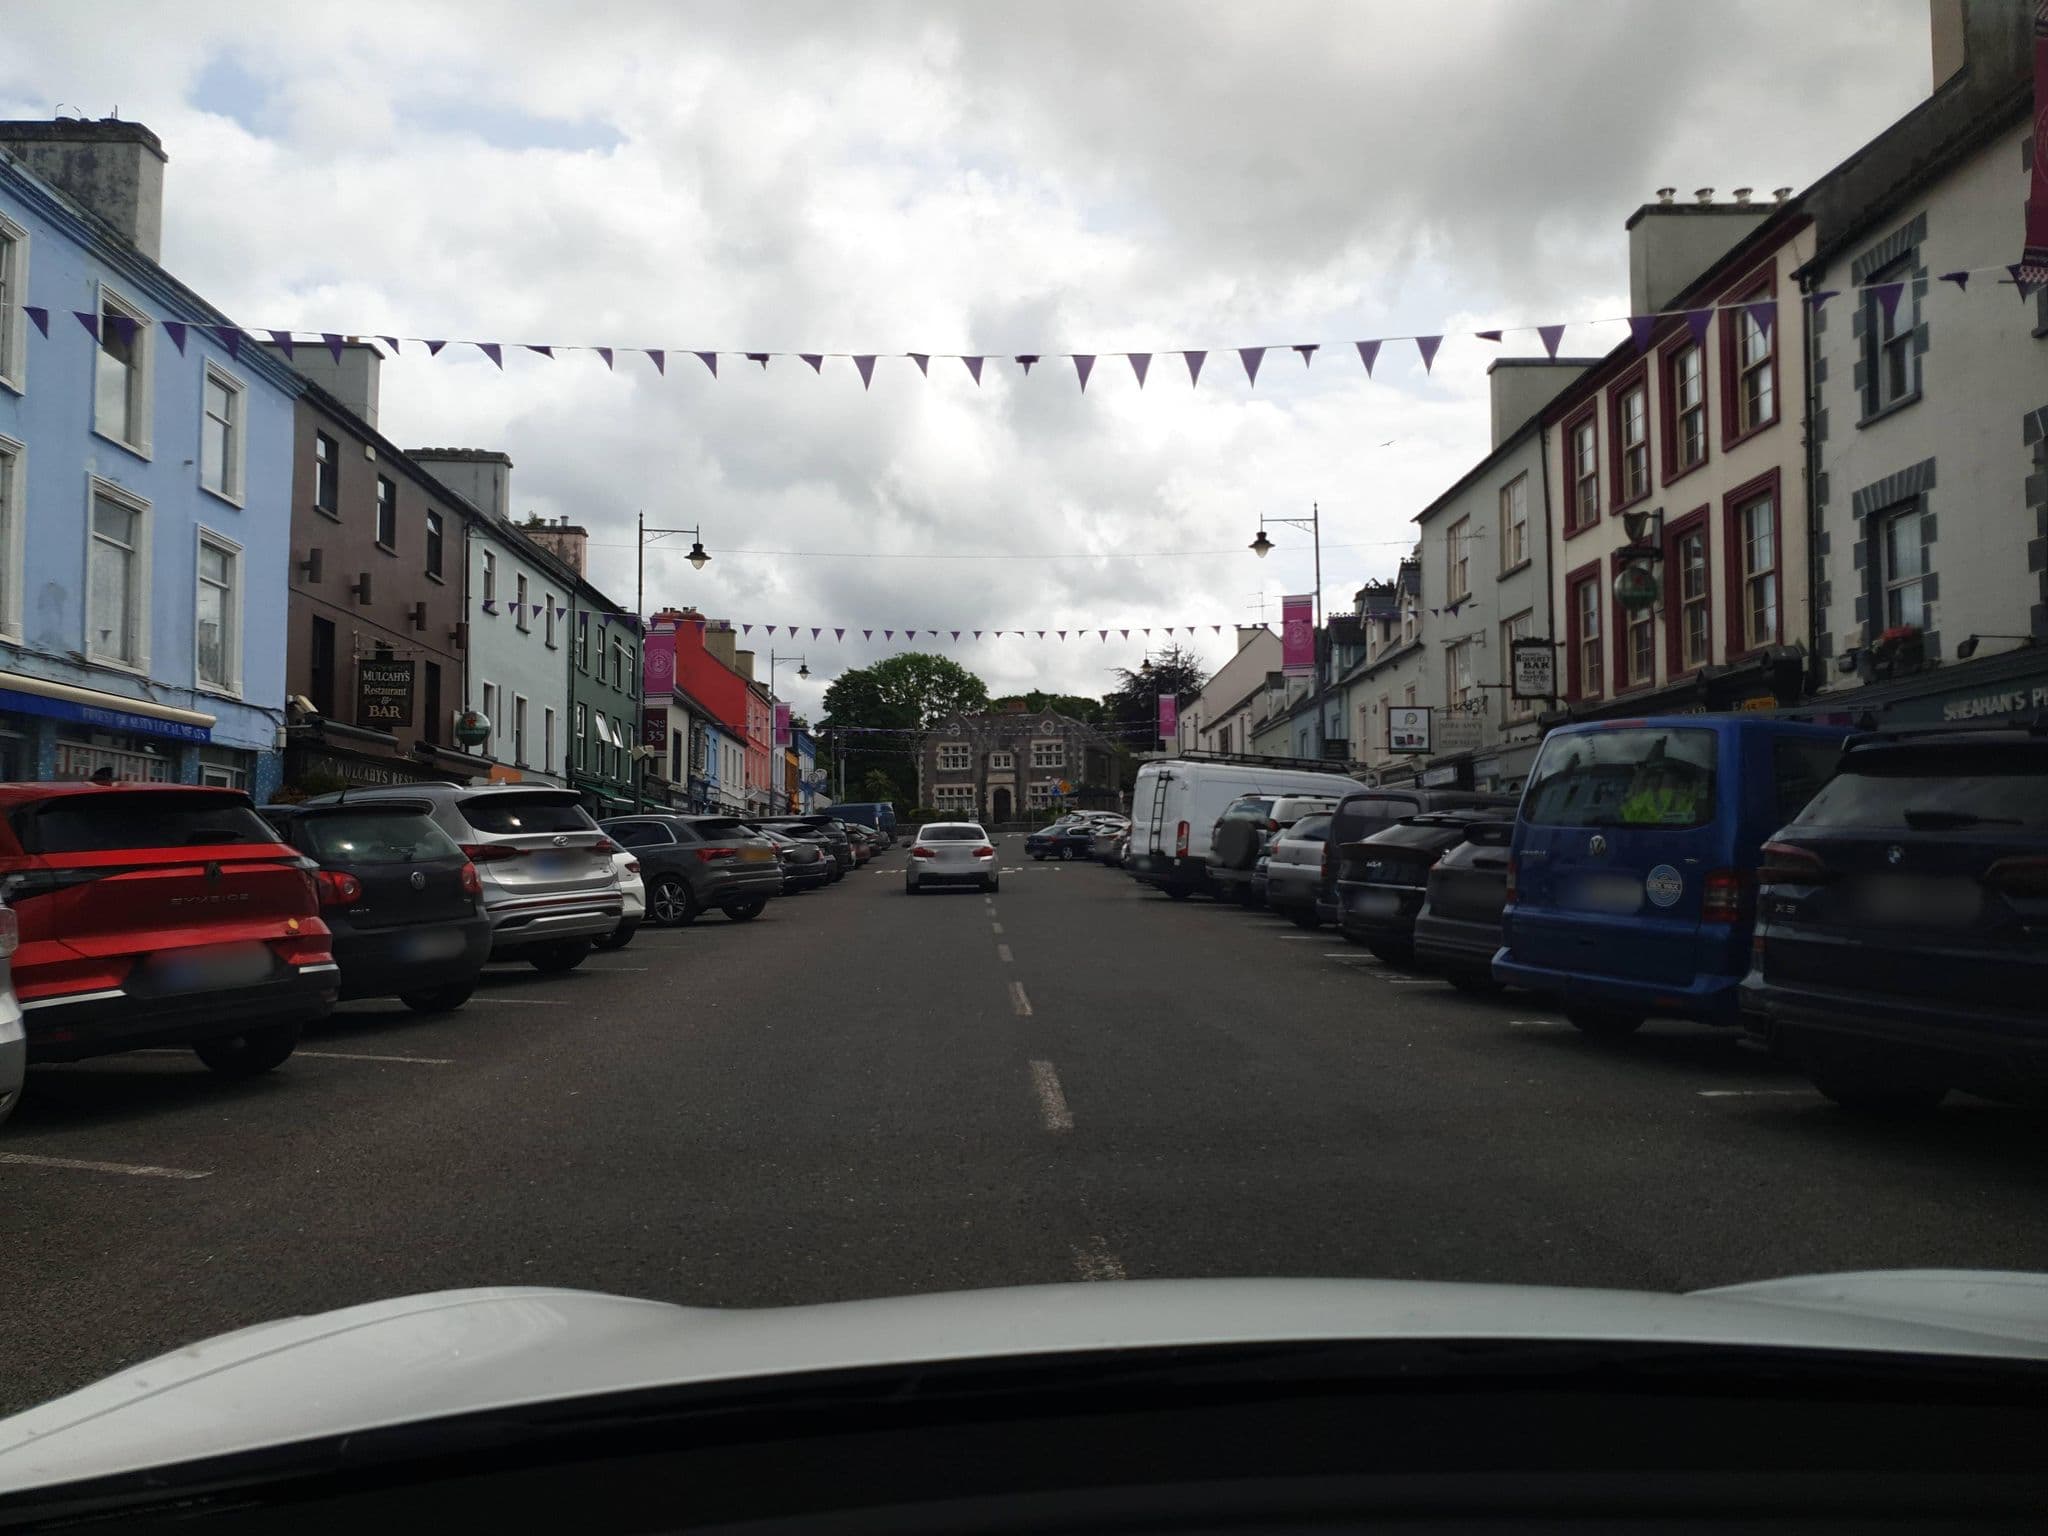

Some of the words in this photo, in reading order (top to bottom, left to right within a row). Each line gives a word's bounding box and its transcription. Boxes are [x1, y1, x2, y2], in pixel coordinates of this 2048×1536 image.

[363, 684, 406, 696] Restaurant
[368, 704, 401, 719] BAR
[647, 731, 665, 742] 35
